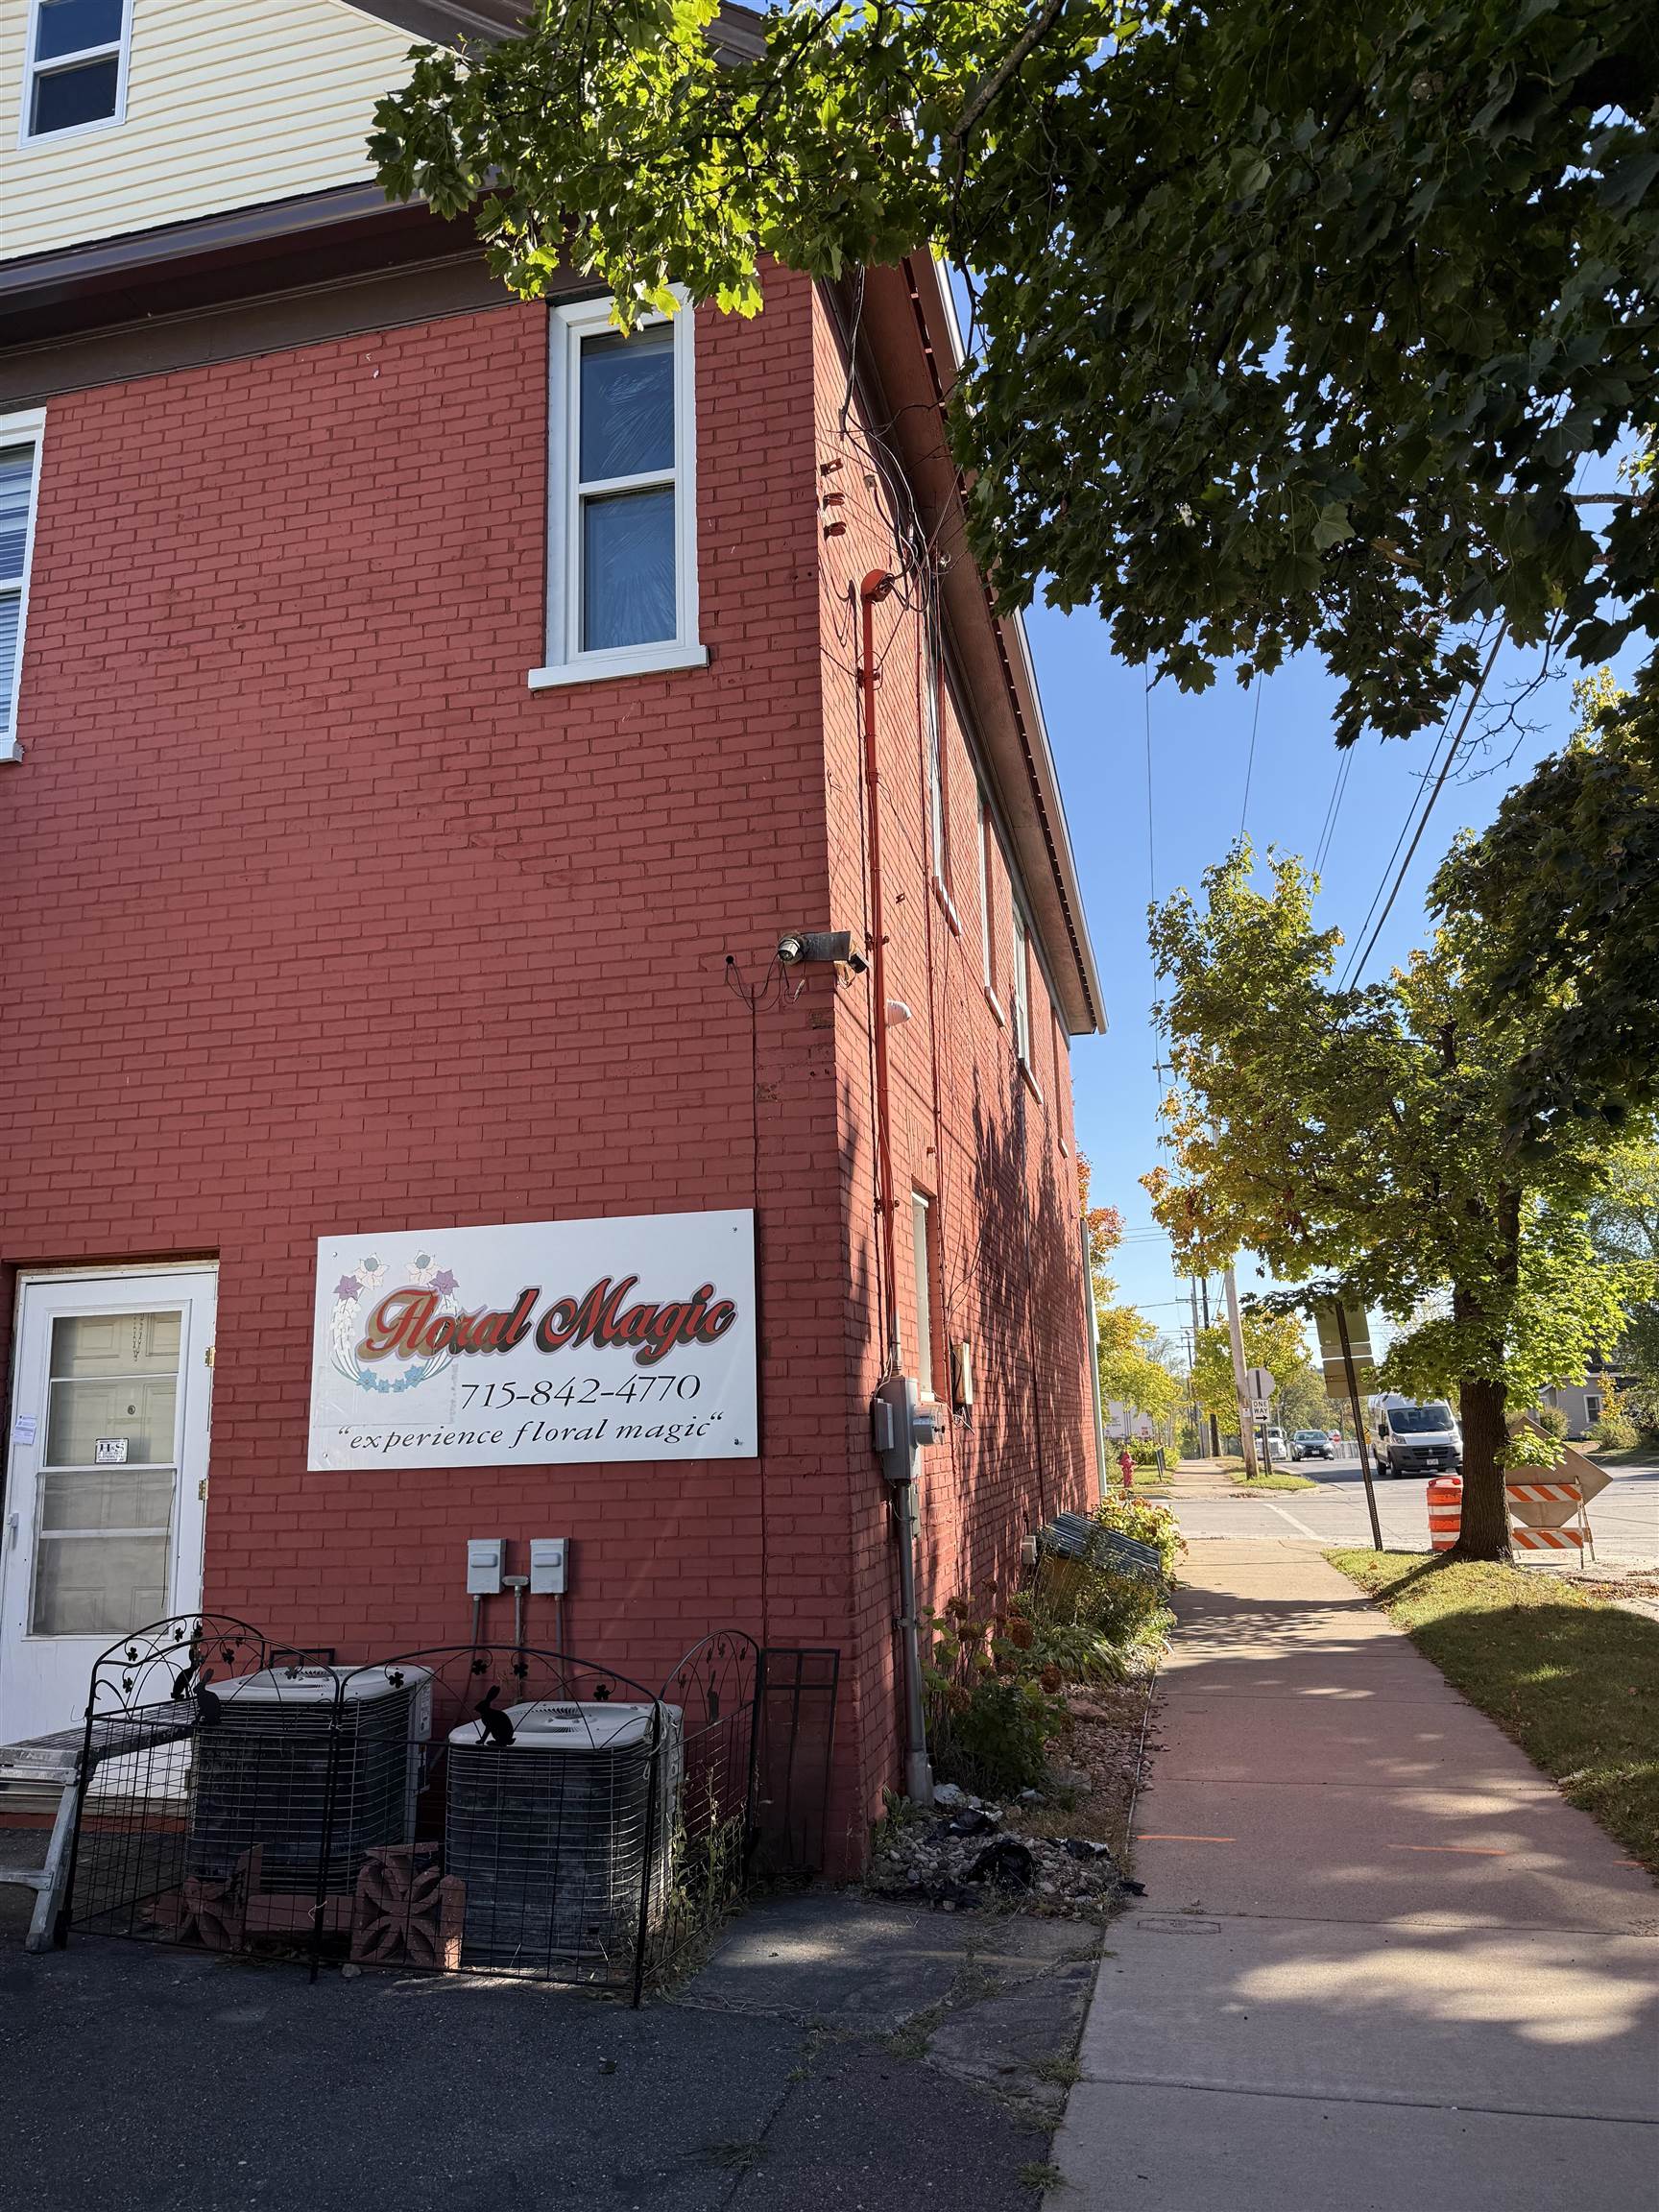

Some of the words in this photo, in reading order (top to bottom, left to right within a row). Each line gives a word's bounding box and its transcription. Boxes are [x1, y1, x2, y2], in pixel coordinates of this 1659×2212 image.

[355, 1284, 542, 1362] Floral
[535, 1273, 738, 1368] Magic
[461, 1374, 701, 1409] 715-842-4770
[509, 1418, 607, 1449] floral
